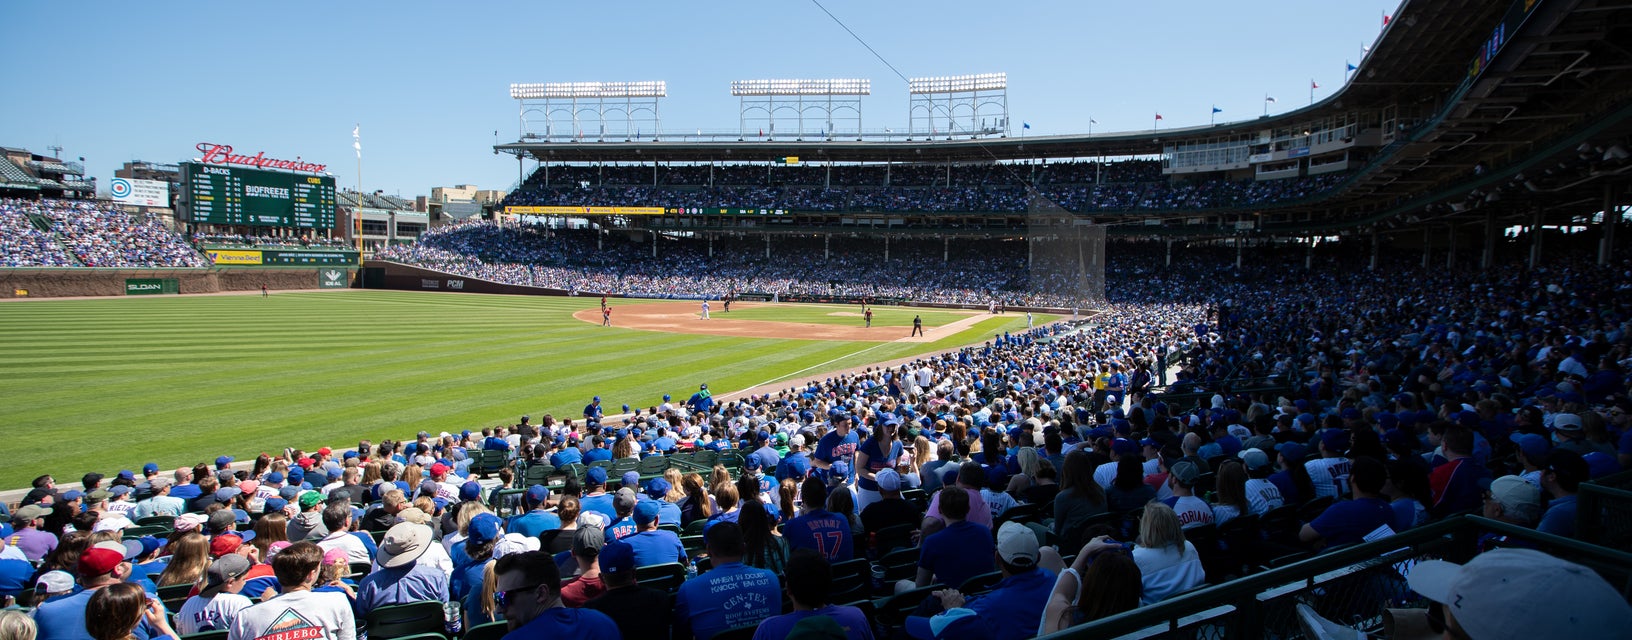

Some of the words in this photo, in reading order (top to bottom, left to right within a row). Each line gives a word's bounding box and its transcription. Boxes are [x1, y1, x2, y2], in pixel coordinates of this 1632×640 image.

[196, 142, 326, 172] Budweiser
[203, 166, 230, 175] D-BACKS
[307, 177, 321, 185] CUBS
[245, 185, 289, 196] BIOFREEZE
[245, 254, 260, 262] Beef
[447, 280, 464, 289] PCM
[109, 504, 131, 512] RIETA
[990, 502, 1003, 511] AEZ
[813, 531, 843, 559] 17
[710, 575, 733, 585] WHEN
[711, 582, 739, 593] KNOCK
[756, 578, 770, 586] OUT
[723, 592, 768, 610] CEN-TEX
[194, 610, 221, 624] BAEZ
